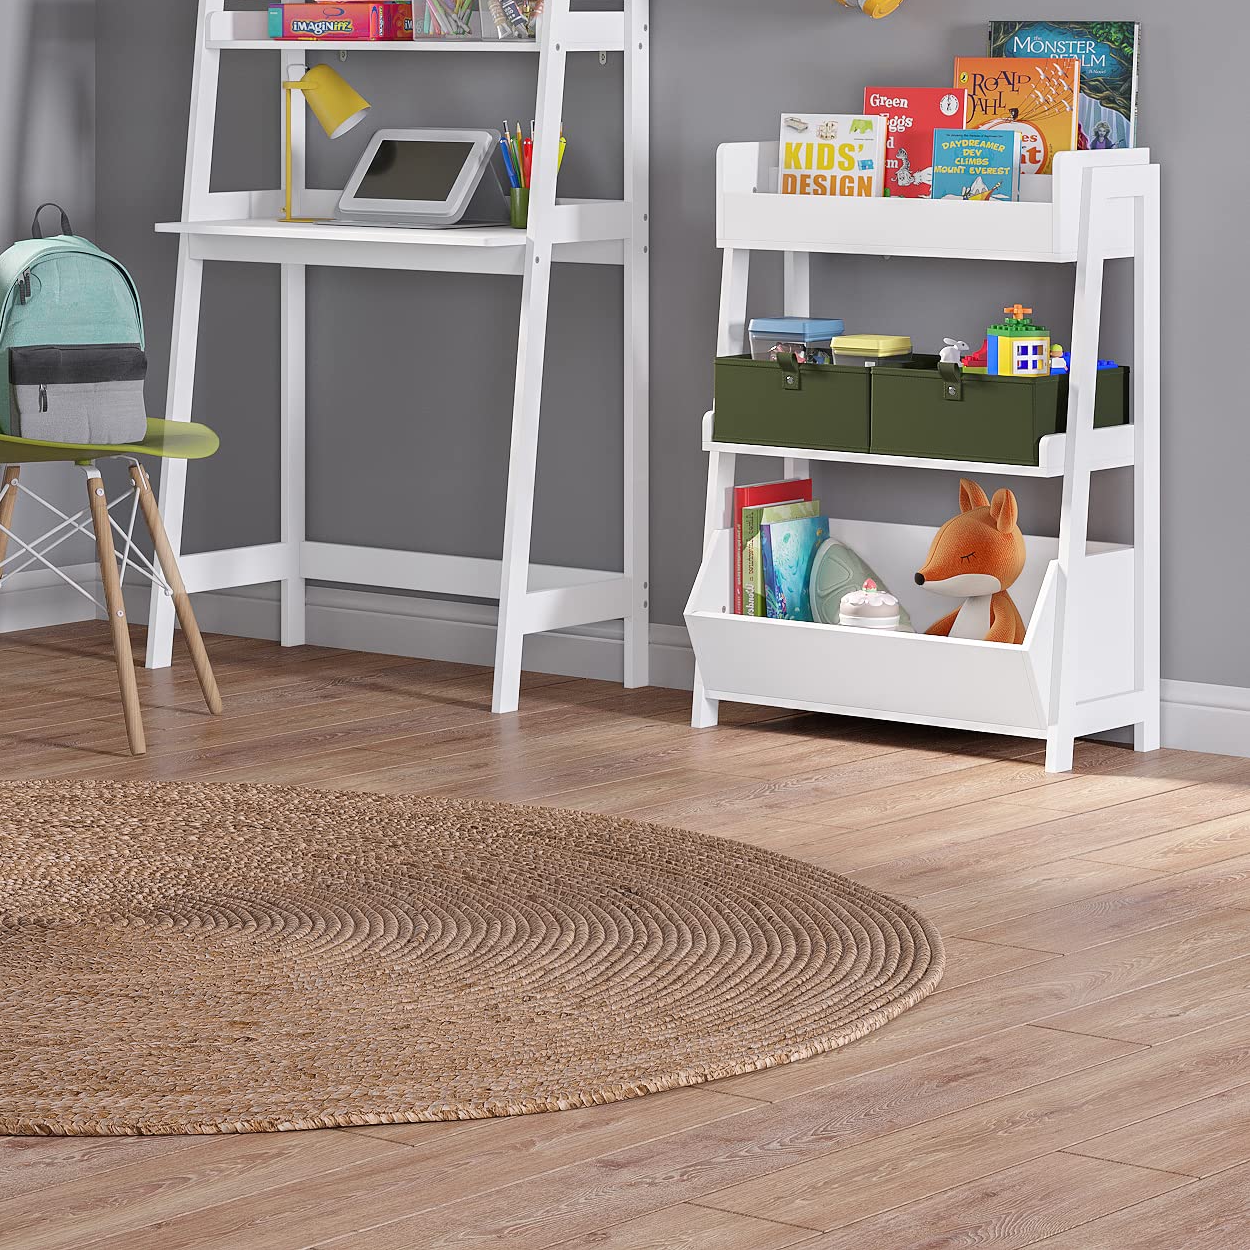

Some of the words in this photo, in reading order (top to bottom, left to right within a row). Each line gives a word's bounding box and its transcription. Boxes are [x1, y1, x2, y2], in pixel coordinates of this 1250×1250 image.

[1013, 36, 1096, 54] MONSTER
[971, 70, 1032, 97] ROALD
[869, 93, 909, 109] Green
[941, 139, 1006, 153] DAYDREAMER
[962, 148, 983, 157] DEV
[783, 142, 864, 172] KIDS'
[933, 165, 967, 175] MOUNT
[969, 166, 1011, 175] EVEREST
[781, 173, 873, 198] DESIGN
